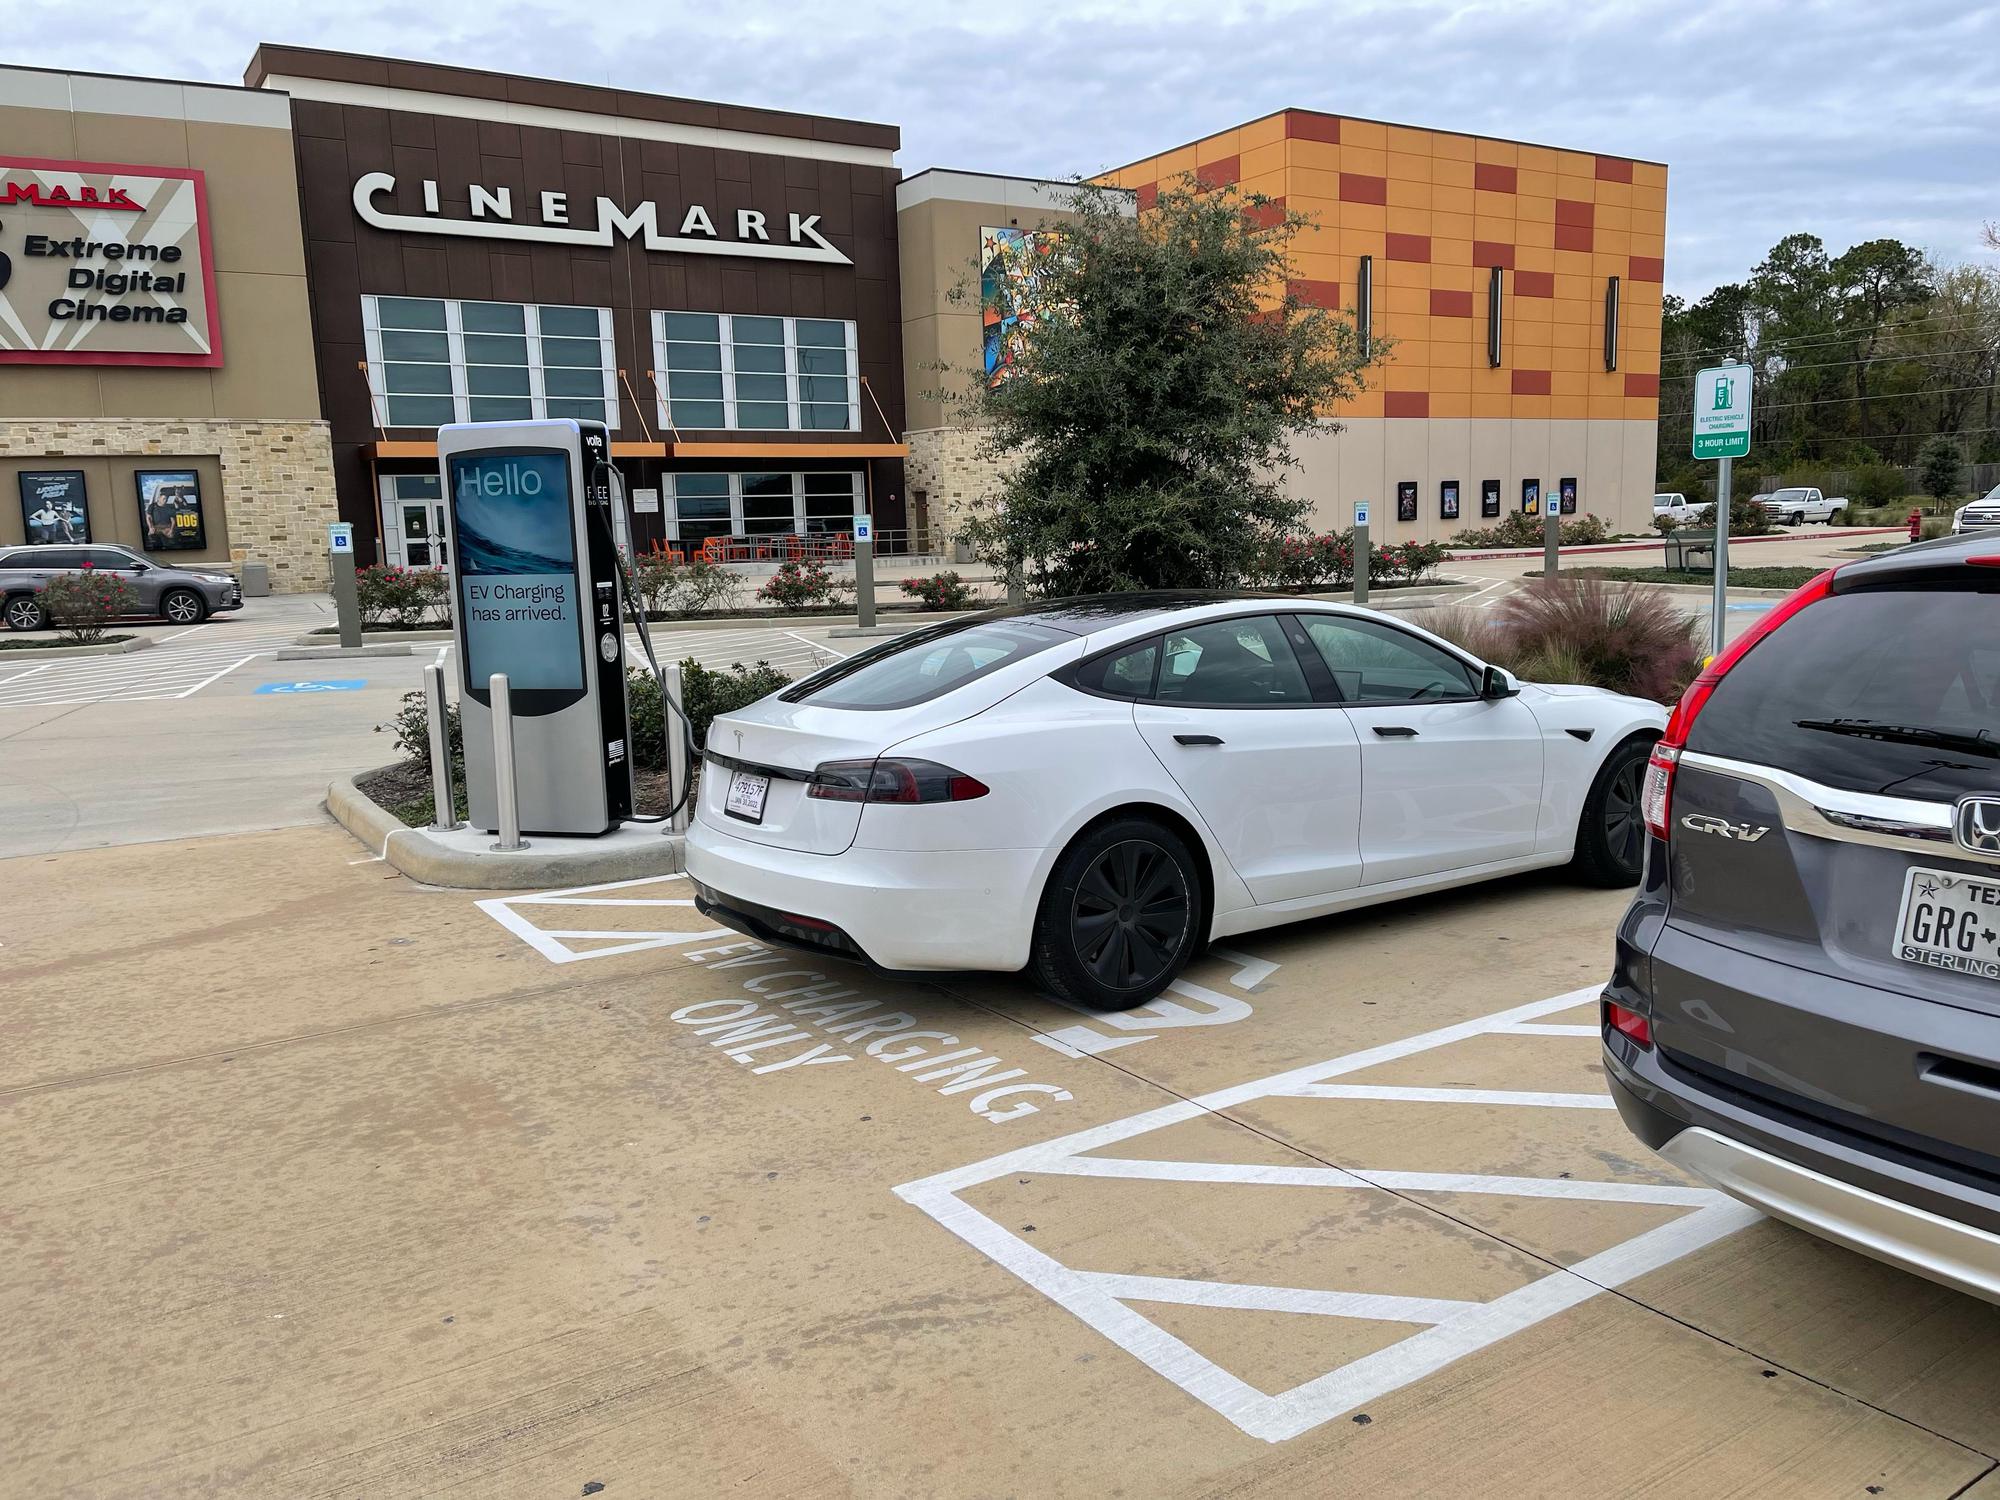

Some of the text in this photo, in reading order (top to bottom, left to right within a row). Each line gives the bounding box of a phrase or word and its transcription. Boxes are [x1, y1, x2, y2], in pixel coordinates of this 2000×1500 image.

[353, 172, 854, 264] CINEMARK
[24, 235, 182, 263] Extreme
[68, 268, 186, 295] Digital
[48, 298, 188, 323] Cinema
[1700, 413, 1744, 423] ELECTRIC VEHICLE
[1708, 422, 1734, 430] CHARGING
[585, 435, 602, 447] volta
[1704, 438, 1724, 448] HOUR
[1725, 437, 1744, 446] LIMIT
[460, 464, 542, 497] Hello
[587, 485, 608, 499] FEE
[176, 513, 197, 528] DOG
[470, 584, 565, 603] EV Charging
[472, 606, 566, 621] has arrived.
[1681, 813, 1771, 842] CR-V
[683, 941, 789, 970] EV
[1904, 947, 1999, 977] STERLING
[670, 999, 855, 1075] ONLY
[743, 971, 1074, 1124] CHARGING
